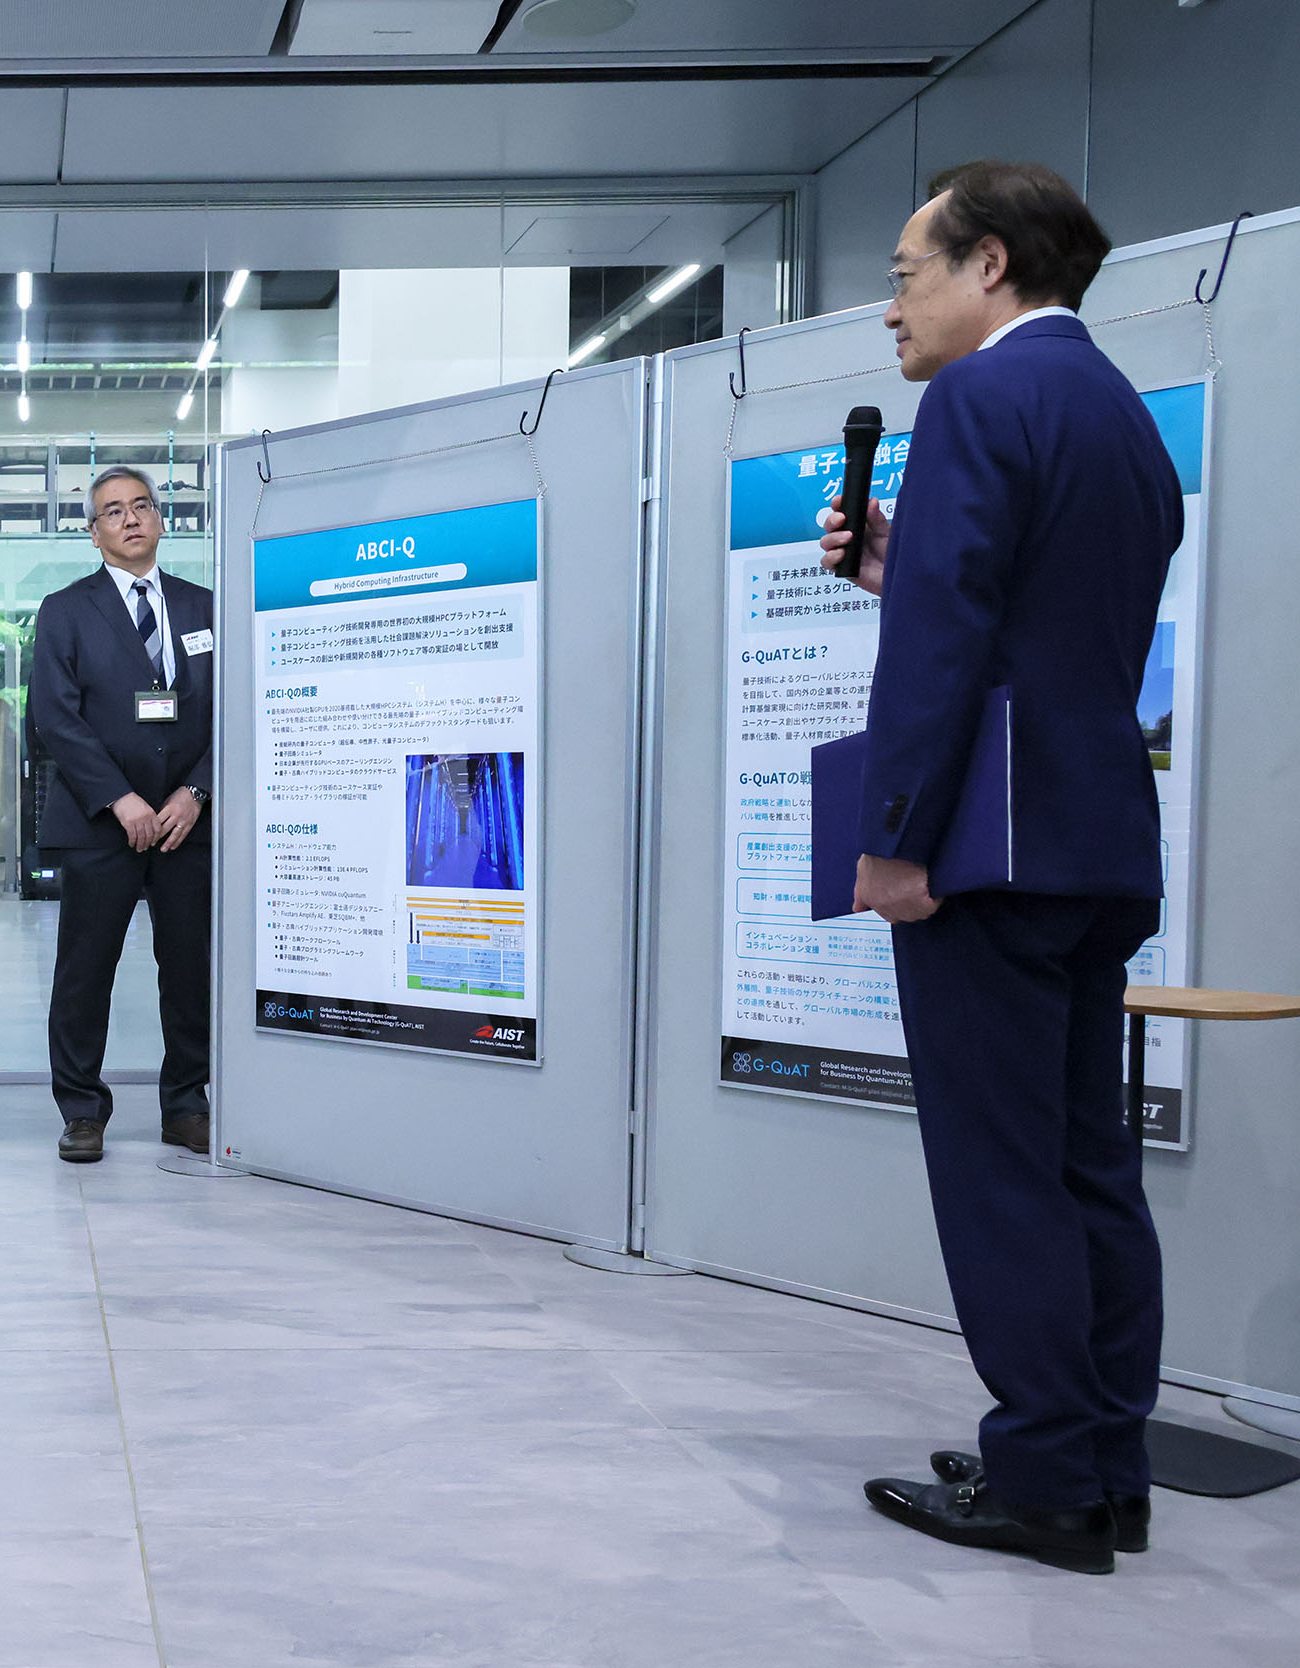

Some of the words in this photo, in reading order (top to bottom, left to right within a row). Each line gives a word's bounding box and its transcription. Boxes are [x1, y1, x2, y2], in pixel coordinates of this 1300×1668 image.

[798, 440, 910, 477] 量子・融合
[822, 467, 905, 501] グーバ
[356, 536, 416, 561] ABCI-Q
[334, 580, 356, 591] Hybrid
[356, 575, 392, 588] Computing
[392, 570, 439, 583] Infrastructure
[265, 685, 318, 699] ABCI-Qの概要
[741, 730, 862, 741] 標準化活動、量子人材育成に取り
[265, 824, 318, 836] ABCI-Qの仕様
[277, 1006, 314, 1020] G-QuAT
[332, 1007, 350, 1015] Research
[736, 1010, 805, 1026] して活動しています。
[493, 1027, 525, 1041] AIST
[753, 1059, 810, 1078] G-QuAT
[820, 1061, 840, 1070] Global
[840, 1063, 868, 1073] Research
[830, 1070, 856, 1079] Business
[857, 1073, 864, 1082] by
